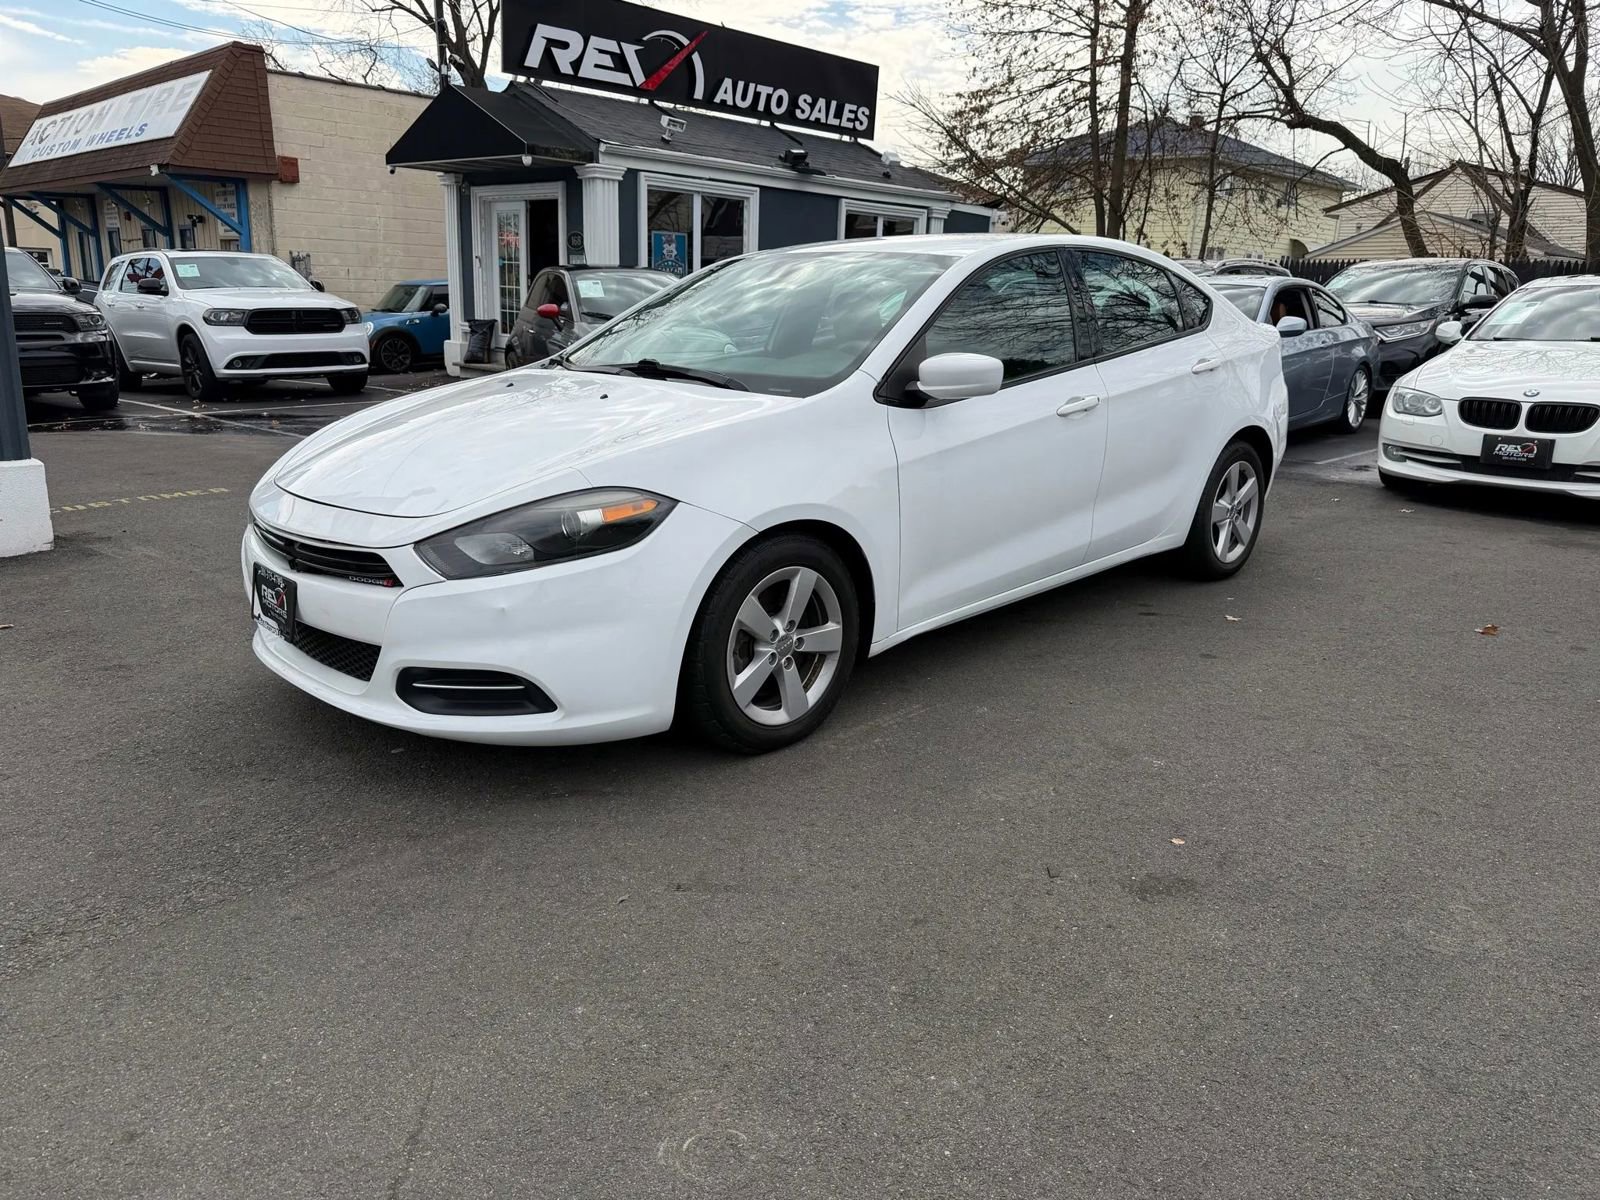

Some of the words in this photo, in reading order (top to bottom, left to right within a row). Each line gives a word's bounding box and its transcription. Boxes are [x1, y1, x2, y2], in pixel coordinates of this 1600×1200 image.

[523, 22, 709, 91] REV
[714, 77, 789, 116] AUTO
[794, 93, 870, 132] SALES
[25, 103, 112, 146] ACTION
[124, 80, 200, 123] TIRE
[31, 137, 81, 158] CUSTOM
[85, 122, 149, 147] WHEELS
[349, 575, 384, 585] DODGE
